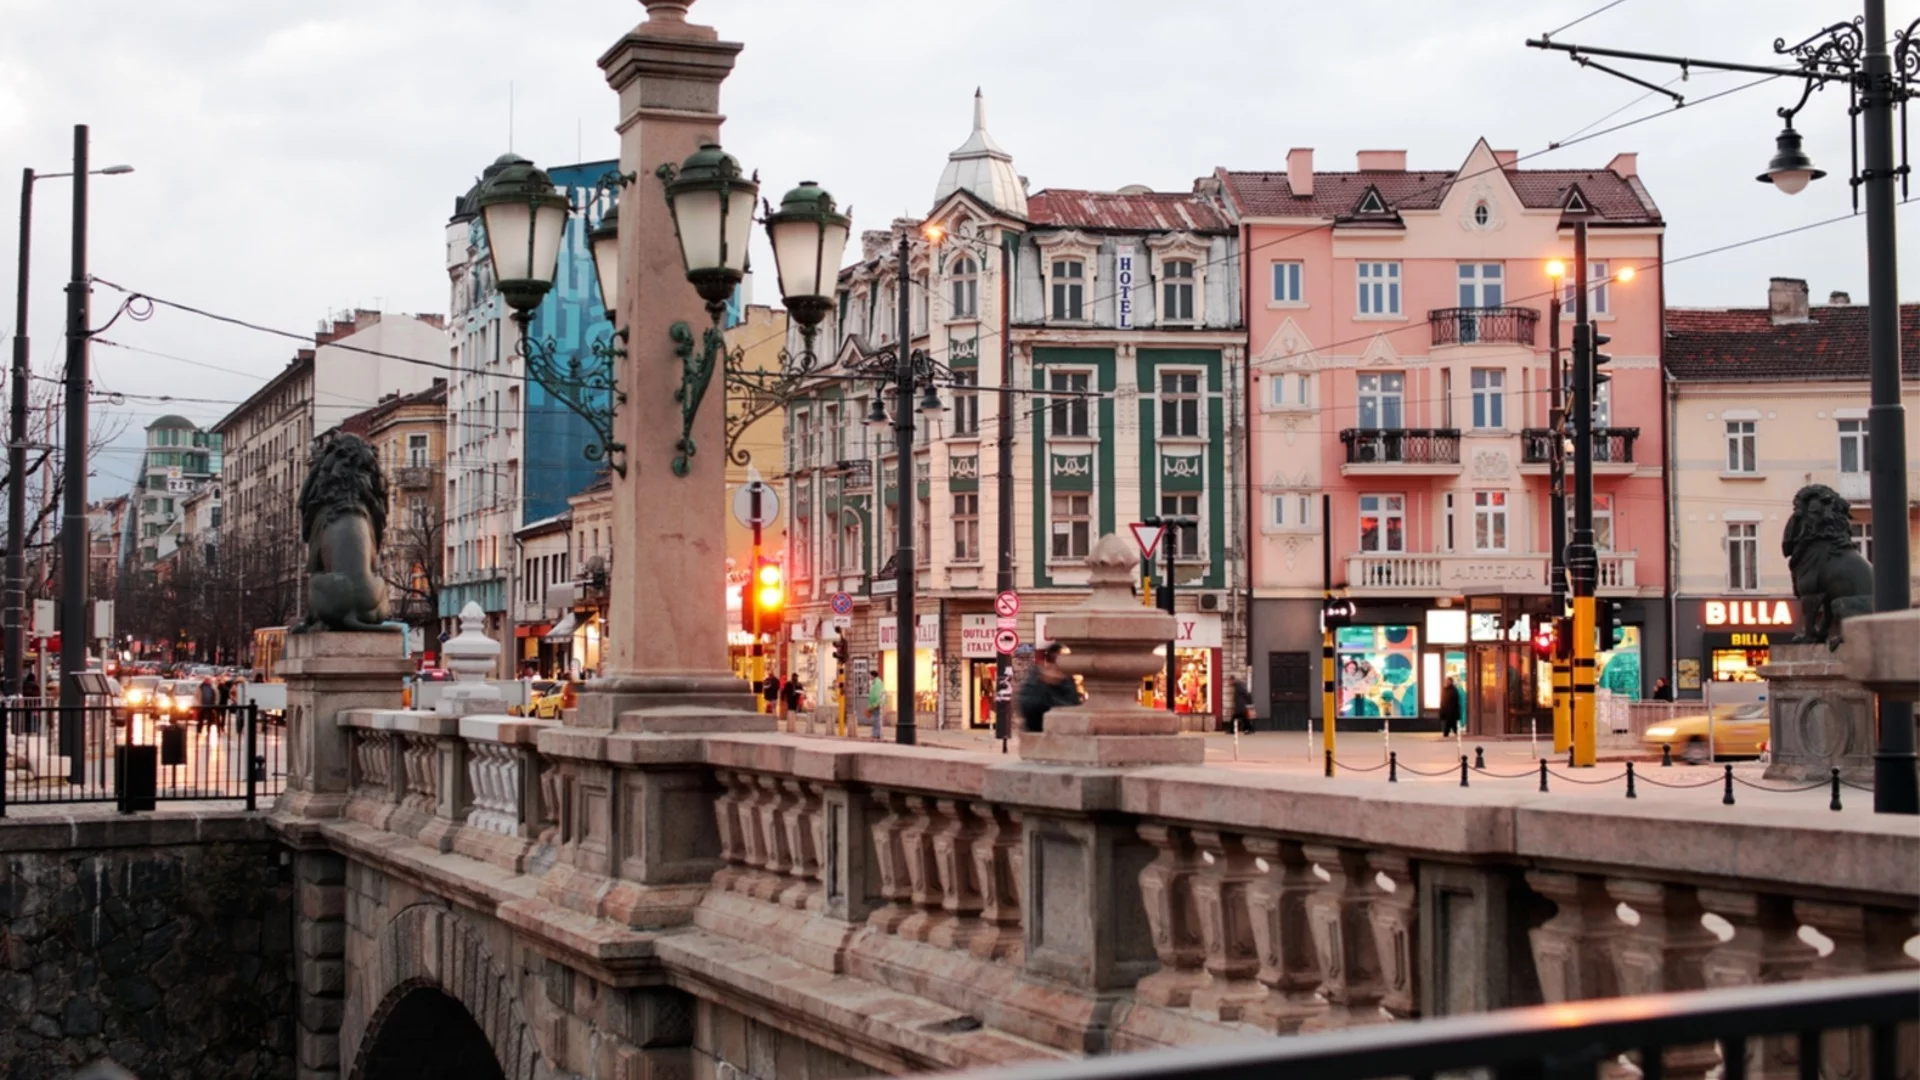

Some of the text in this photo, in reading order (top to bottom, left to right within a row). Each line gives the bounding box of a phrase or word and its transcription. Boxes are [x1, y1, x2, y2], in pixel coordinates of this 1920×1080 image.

[1119, 257, 1132, 328] HOTEL
[1449, 564, 1537, 580] АПТЕКА
[1705, 600, 1793, 625] BILLA
[963, 628, 995, 639] OUTLET
[1731, 633, 1769, 646] BILLA
[966, 642, 993, 652] ITALY
